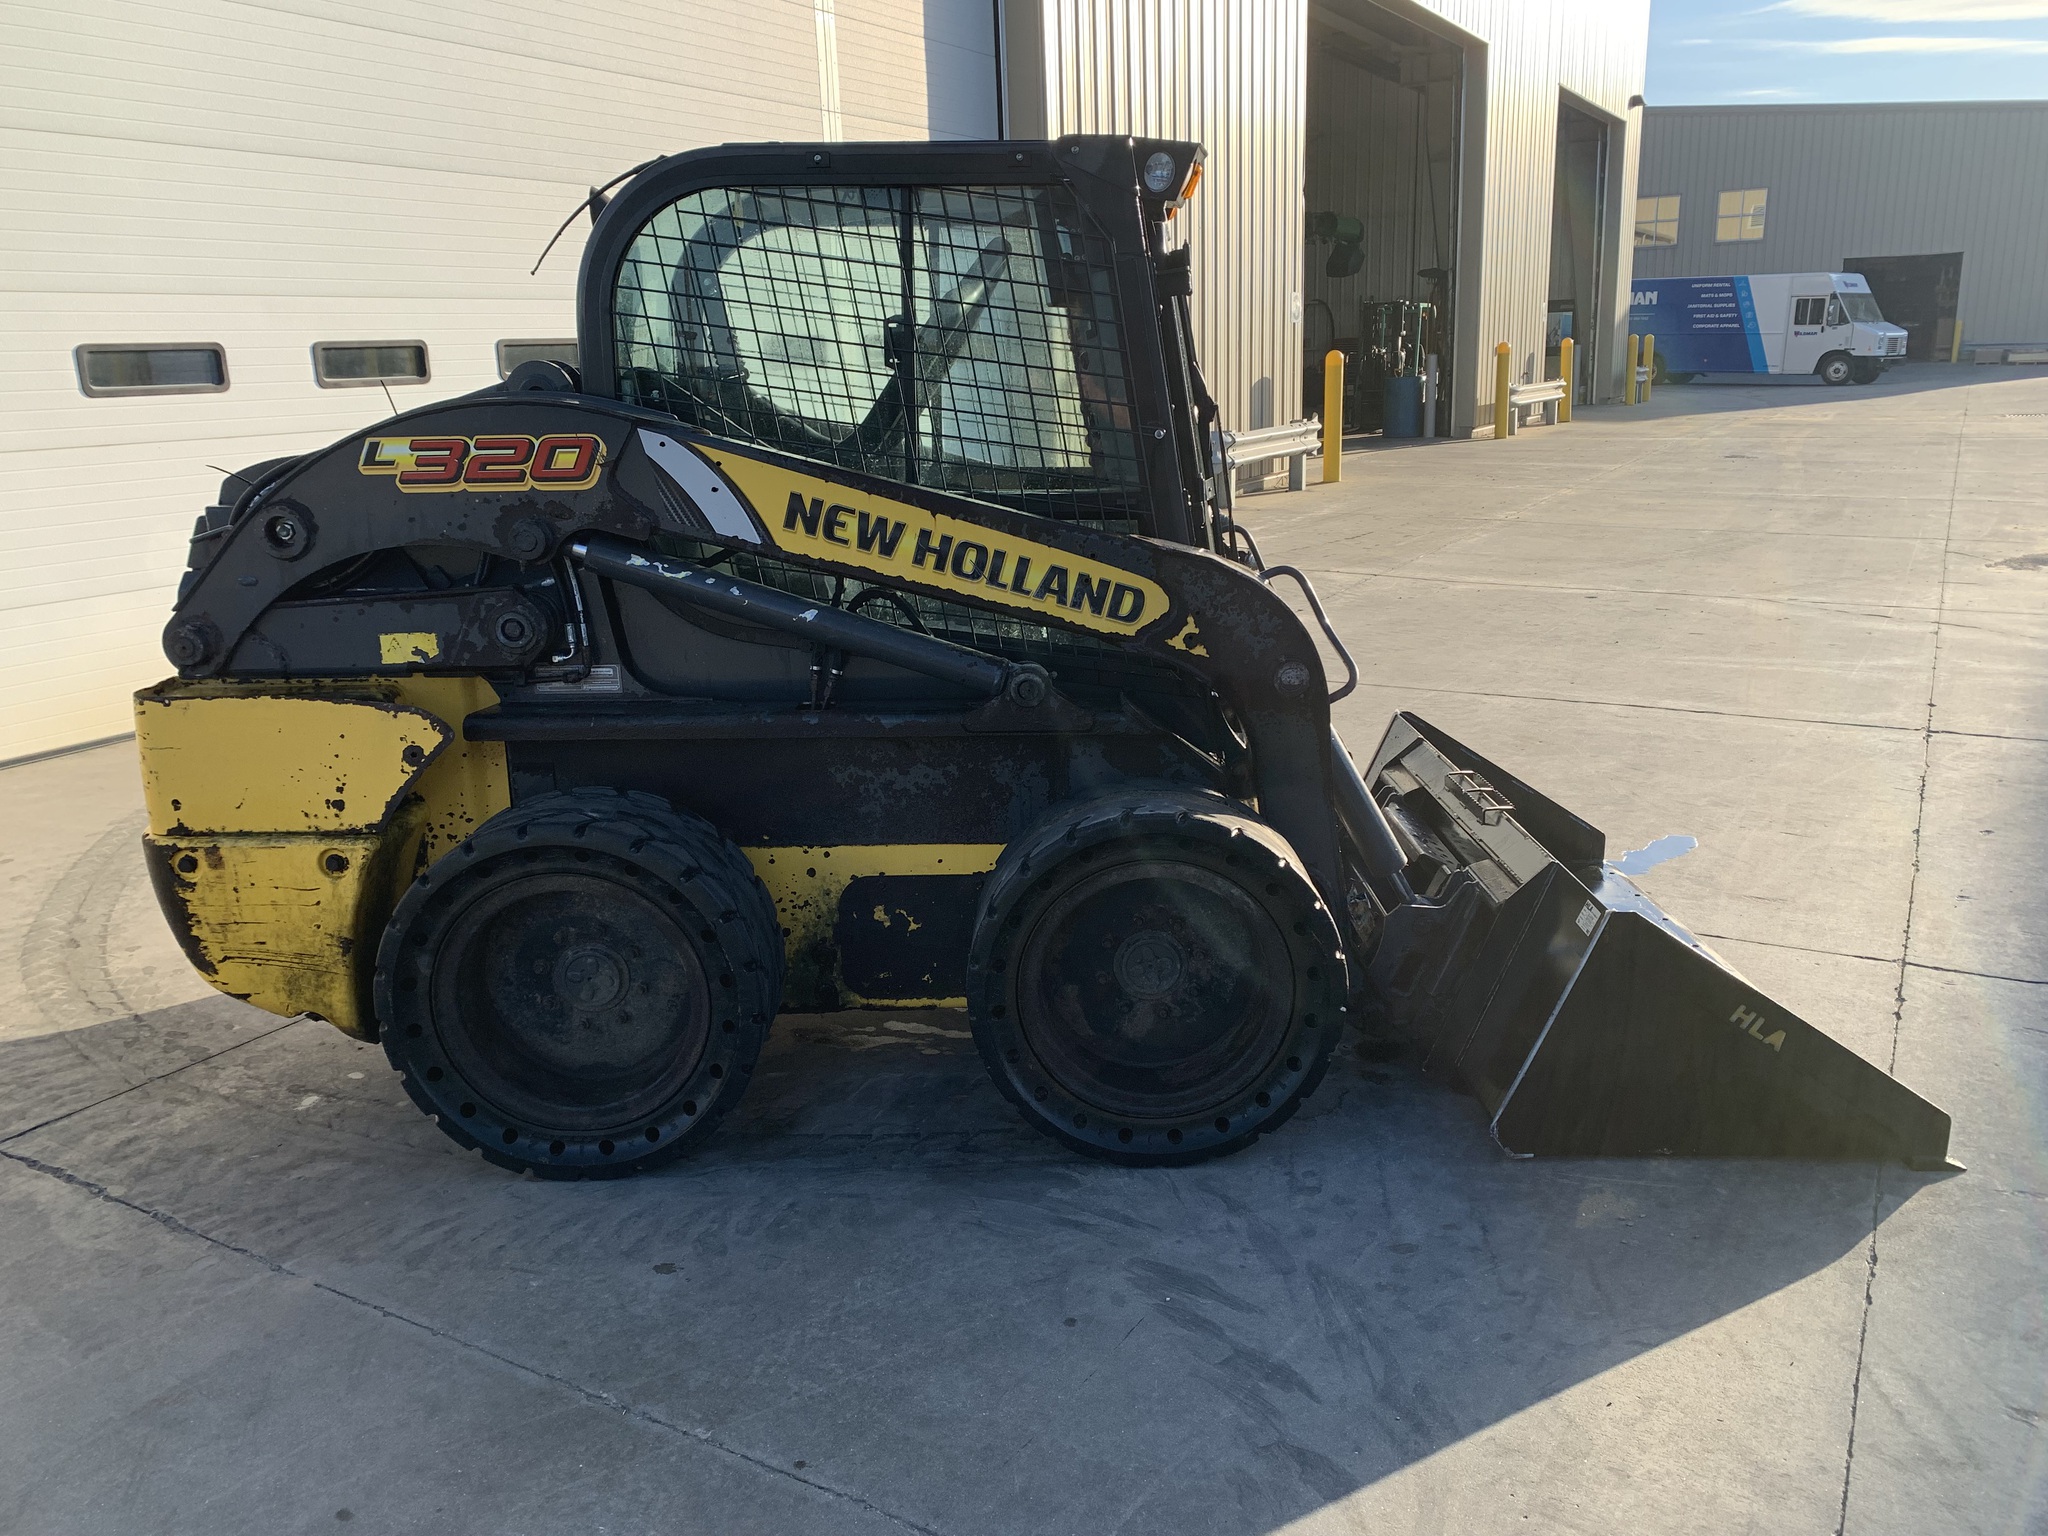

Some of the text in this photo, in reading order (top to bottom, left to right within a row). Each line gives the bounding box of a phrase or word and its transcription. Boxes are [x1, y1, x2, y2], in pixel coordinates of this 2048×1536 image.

[360, 435, 604, 487] L320
[782, 490, 1146, 625] NEW HOLLAND
[1729, 1004, 1787, 1053] HLA
